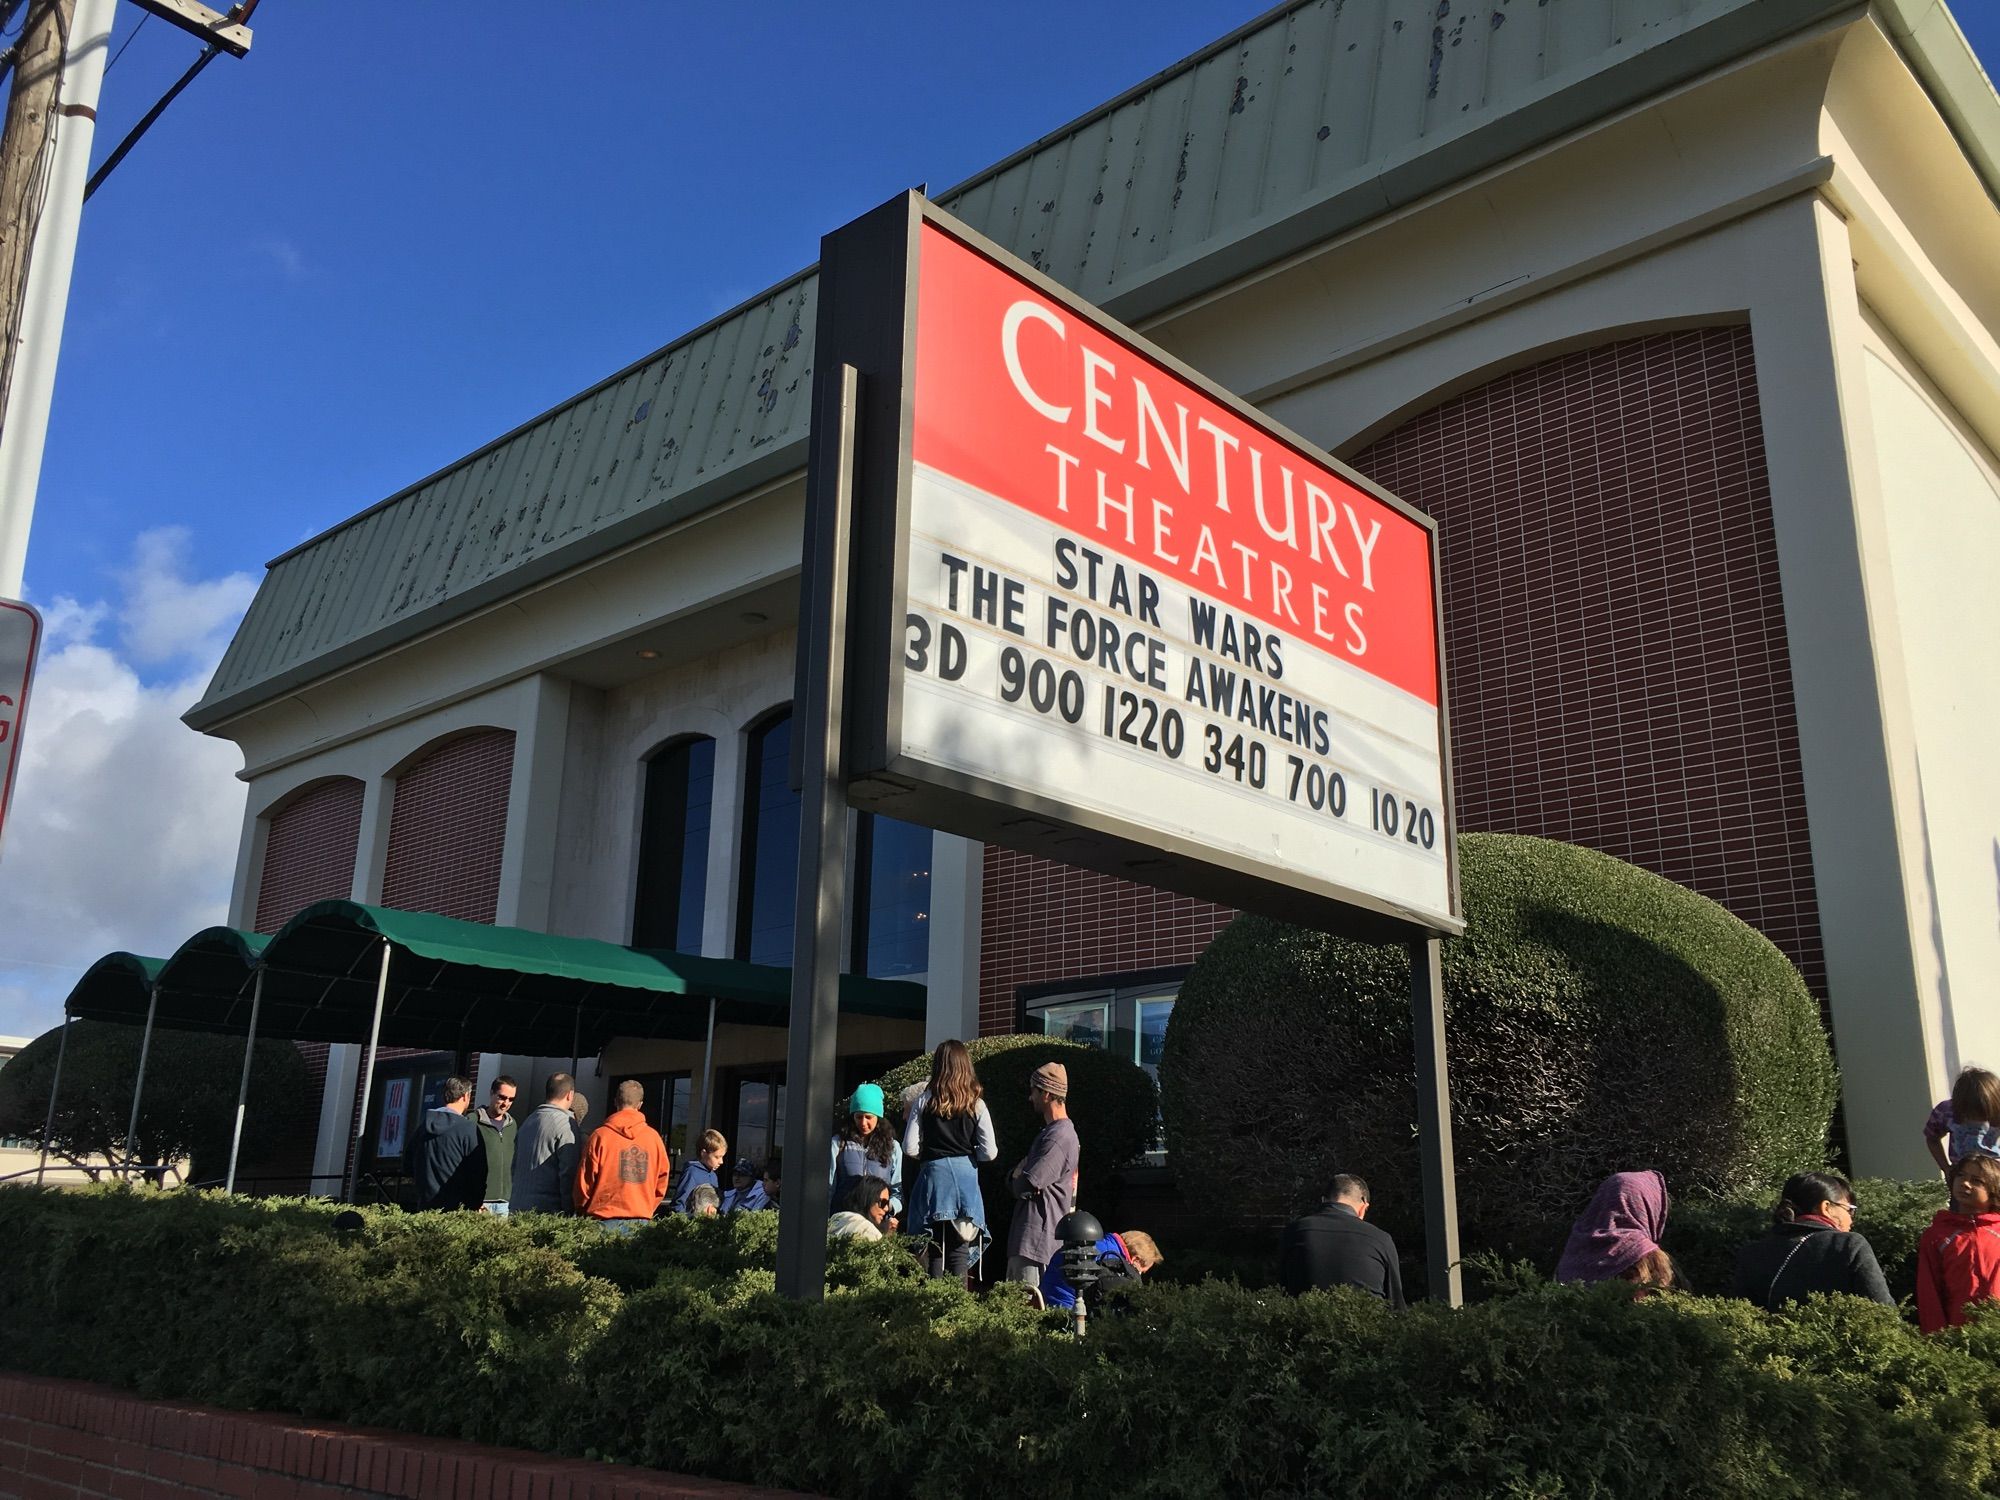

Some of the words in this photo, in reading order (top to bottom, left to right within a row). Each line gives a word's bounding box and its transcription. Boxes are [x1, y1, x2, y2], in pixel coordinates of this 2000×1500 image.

[1002, 300, 1382, 592] CENTURY
[1045, 444, 1367, 656] THEATRES
[1055, 538, 1160, 628] STAR
[1190, 596, 1282, 680] WARS
[905, 614, 967, 681] 3D
[1000, 647, 1084, 723] 900
[1101, 686, 1184, 759] 1220
[1204, 723, 1266, 789] 340
[1288, 754, 1346, 818] 700
[942, 553, 1025, 637] THE
[1047, 596, 1166, 692] FORCE
[1186, 657, 1329, 756] AWAKENS
